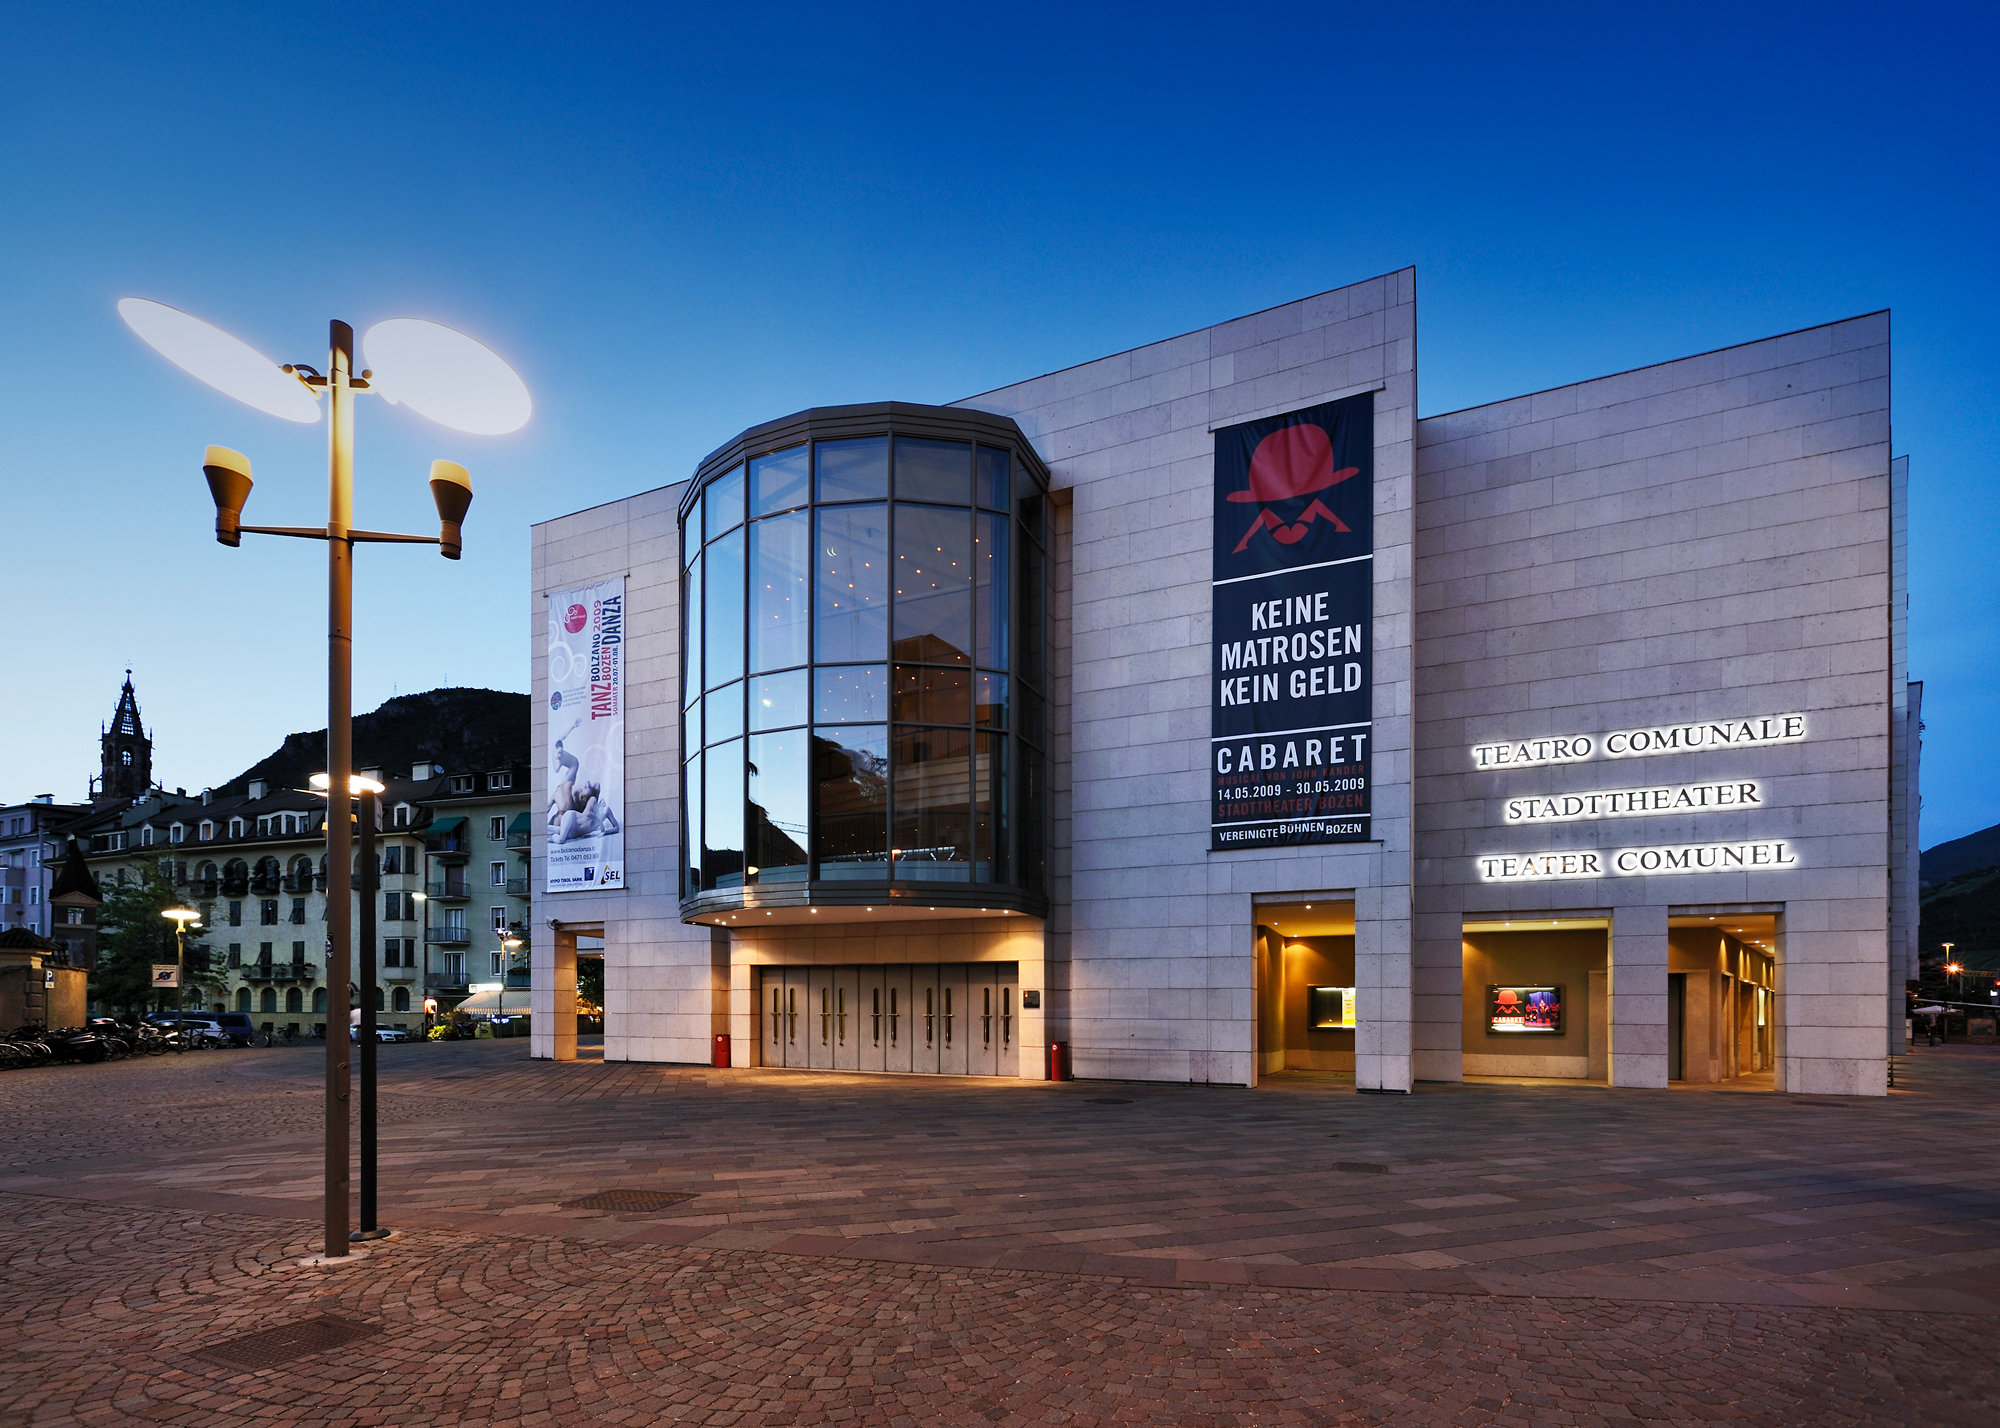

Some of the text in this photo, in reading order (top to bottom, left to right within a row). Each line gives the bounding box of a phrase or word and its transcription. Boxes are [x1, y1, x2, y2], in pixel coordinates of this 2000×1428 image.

[1252, 591, 1329, 631] KEINE
[591, 599, 601, 682] BOLZANO 2009
[591, 595, 621, 720] TANZ BOZEN DANZA
[1221, 623, 1362, 671] MATROSEN
[1220, 662, 1362, 707] KEIN GELD
[1217, 733, 1367, 774] CABARET
[1476, 716, 1805, 766] TEATRO COMUNALE
[1217, 764, 1364, 786] MUSICAL VON JOHN KANDER
[1217, 784, 1281, 801] 14.05.2009
[1296, 777, 1365, 795] 30.05.2009
[1218, 794, 1363, 817] STADTTHEATER BOZEN
[1508, 783, 1761, 820] STADTTHEATER
[1219, 822, 1362, 841] VEREINIGTE BÜHNEN BOZEN
[605, 870, 620, 880] SEL
[1482, 843, 1796, 878] TEATER COMUNEL
[46, 970, 53, 981] P
[1493, 1016, 1523, 1024] CABARET
